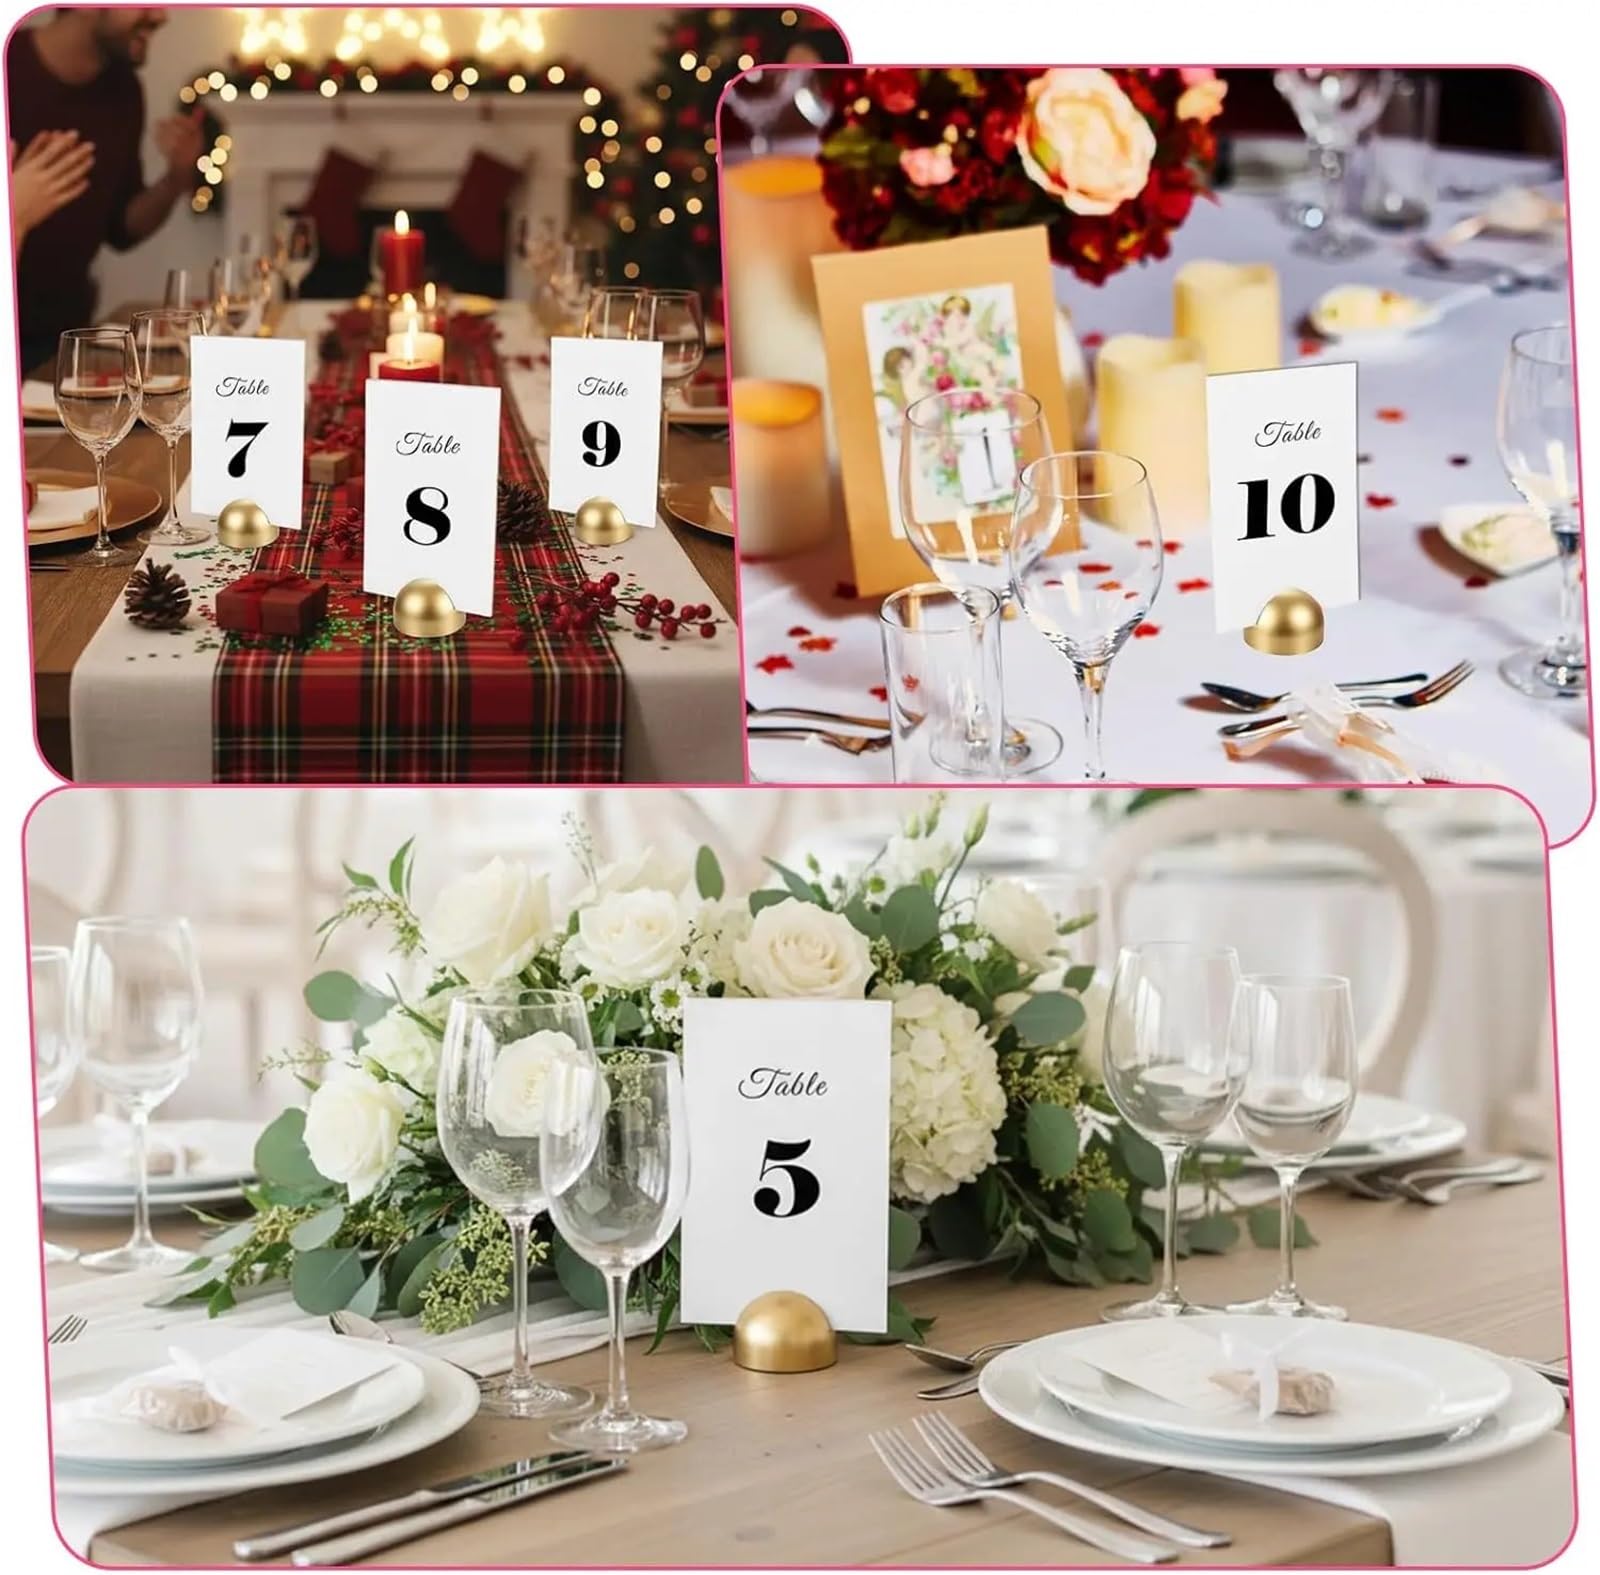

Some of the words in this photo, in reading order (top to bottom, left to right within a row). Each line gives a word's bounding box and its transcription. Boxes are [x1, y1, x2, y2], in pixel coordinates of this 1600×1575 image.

[215, 376, 270, 398] Table
[577, 376, 629, 397] Table
[225, 419, 269, 478] 7
[395, 432, 461, 456] Table
[581, 420, 622, 467] 9
[1254, 420, 1321, 448] Table
[403, 486, 451, 546] 8
[1237, 473, 1336, 542] 10
[738, 1067, 828, 1100] Table
[753, 1138, 821, 1219] 5
